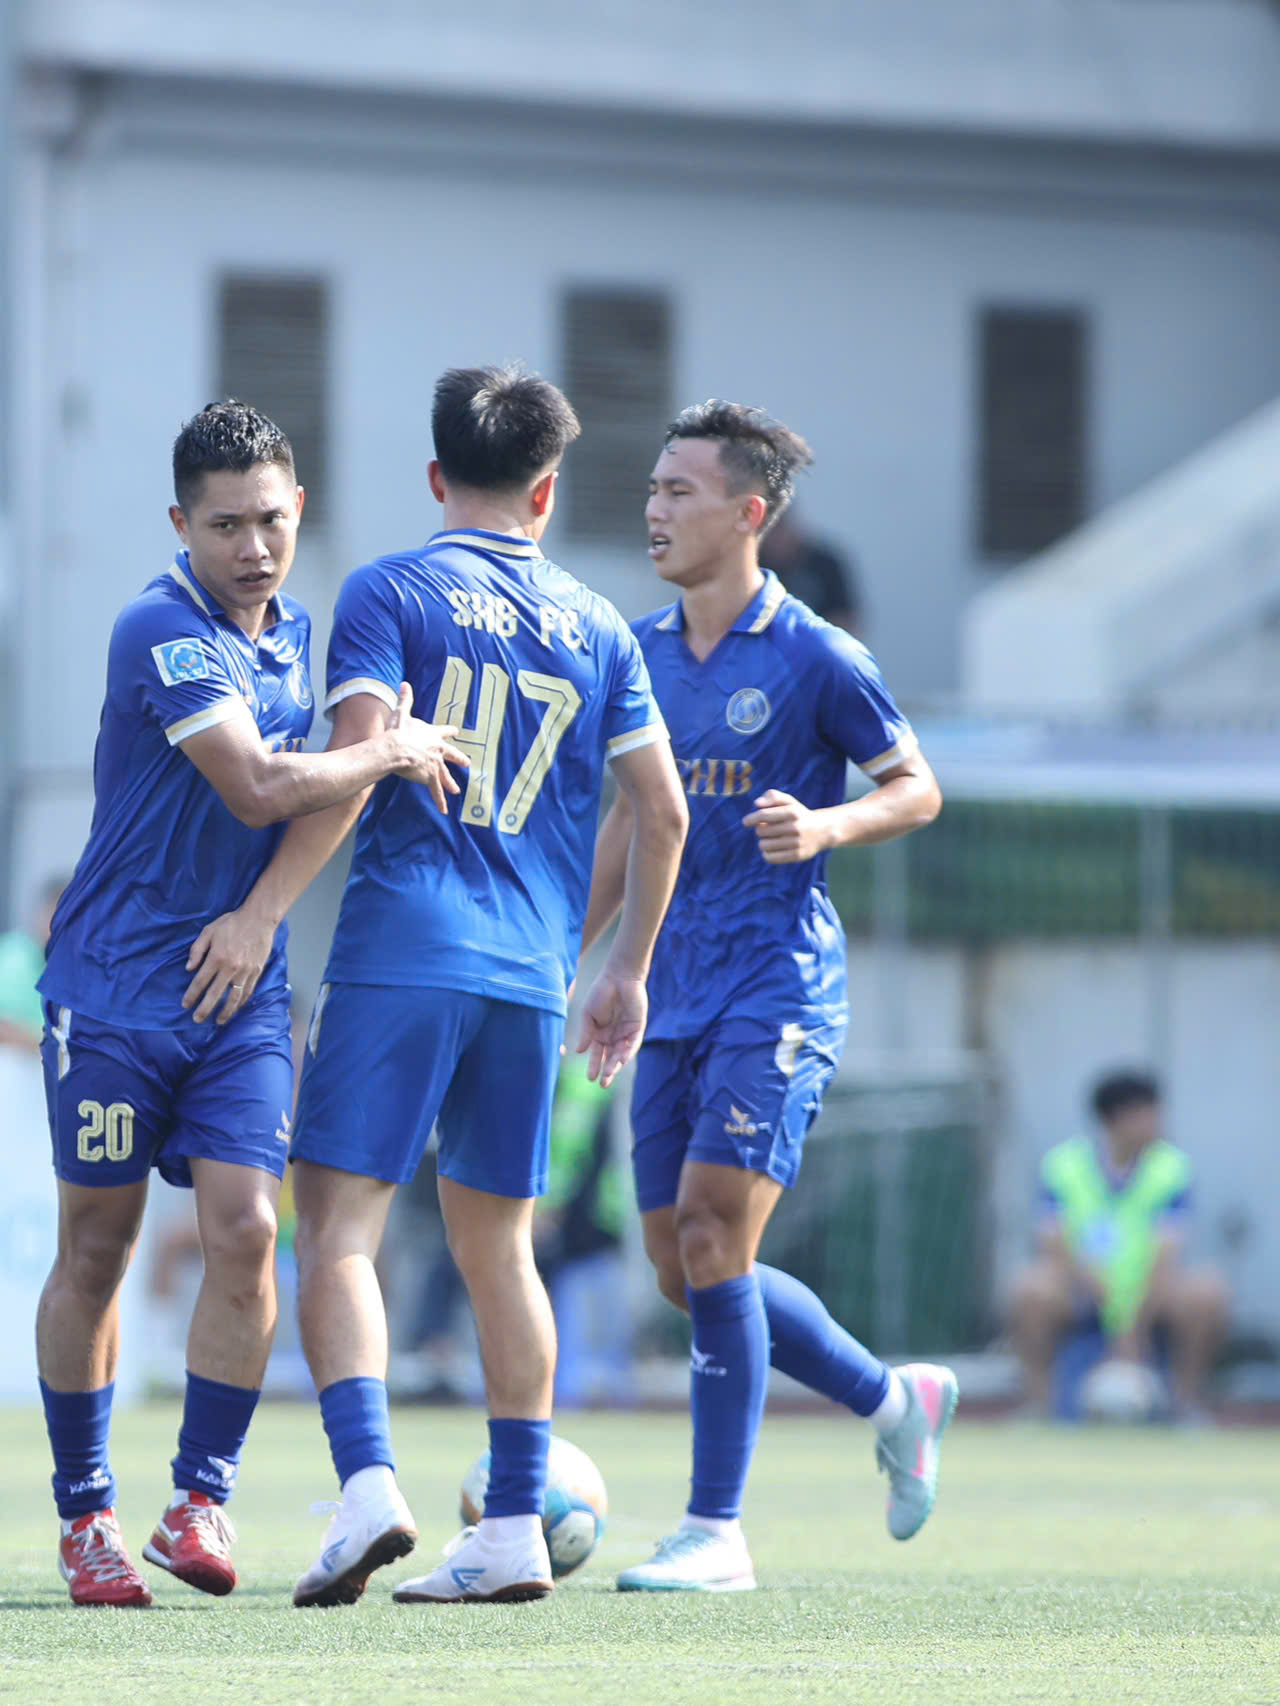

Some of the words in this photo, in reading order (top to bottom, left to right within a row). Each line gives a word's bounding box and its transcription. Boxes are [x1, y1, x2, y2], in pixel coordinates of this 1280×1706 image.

[450, 588, 518, 638] SHB
[433, 655, 583, 835] 47
[77, 1099, 135, 1162] 20
